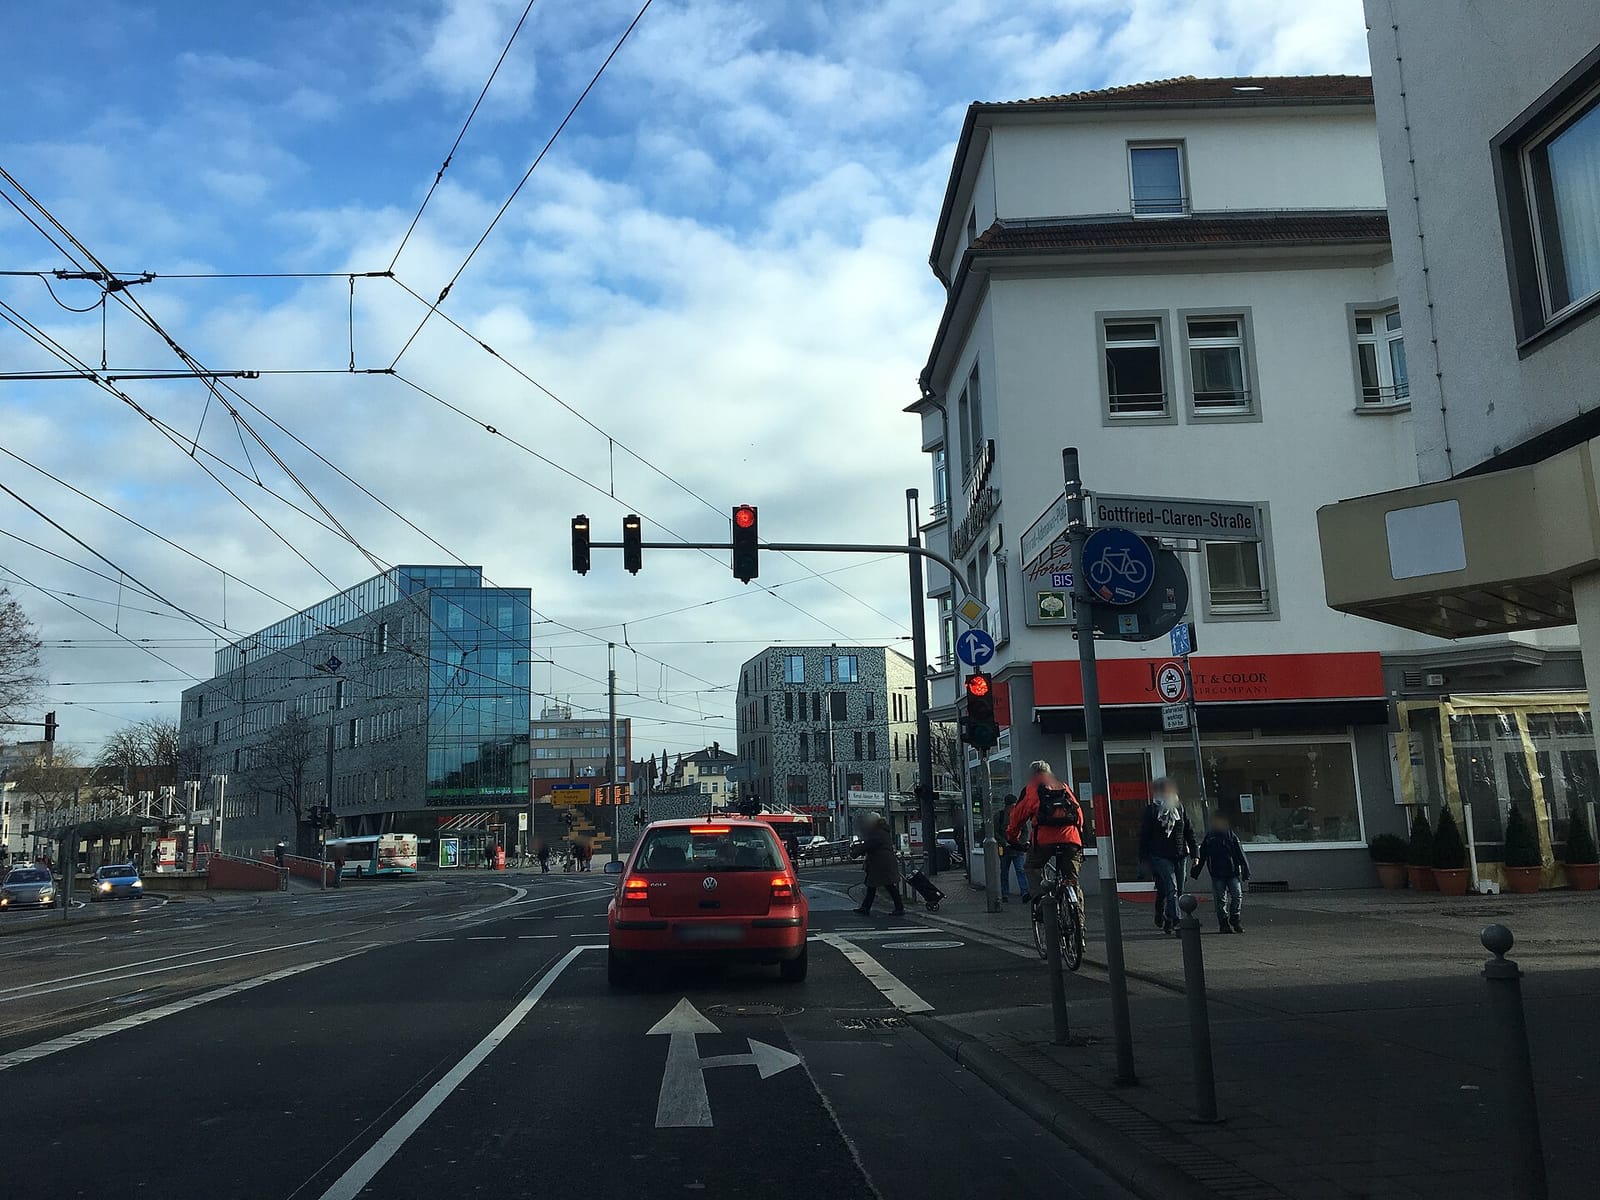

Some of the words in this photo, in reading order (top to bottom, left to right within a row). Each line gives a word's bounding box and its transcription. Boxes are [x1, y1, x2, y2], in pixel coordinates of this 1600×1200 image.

[1098, 505, 1252, 530] Gottfried-Claren-Straße
[1054, 574, 1073, 587] BIS
[1211, 674, 1219, 684] &
[1223, 672, 1267, 684] COLOR
